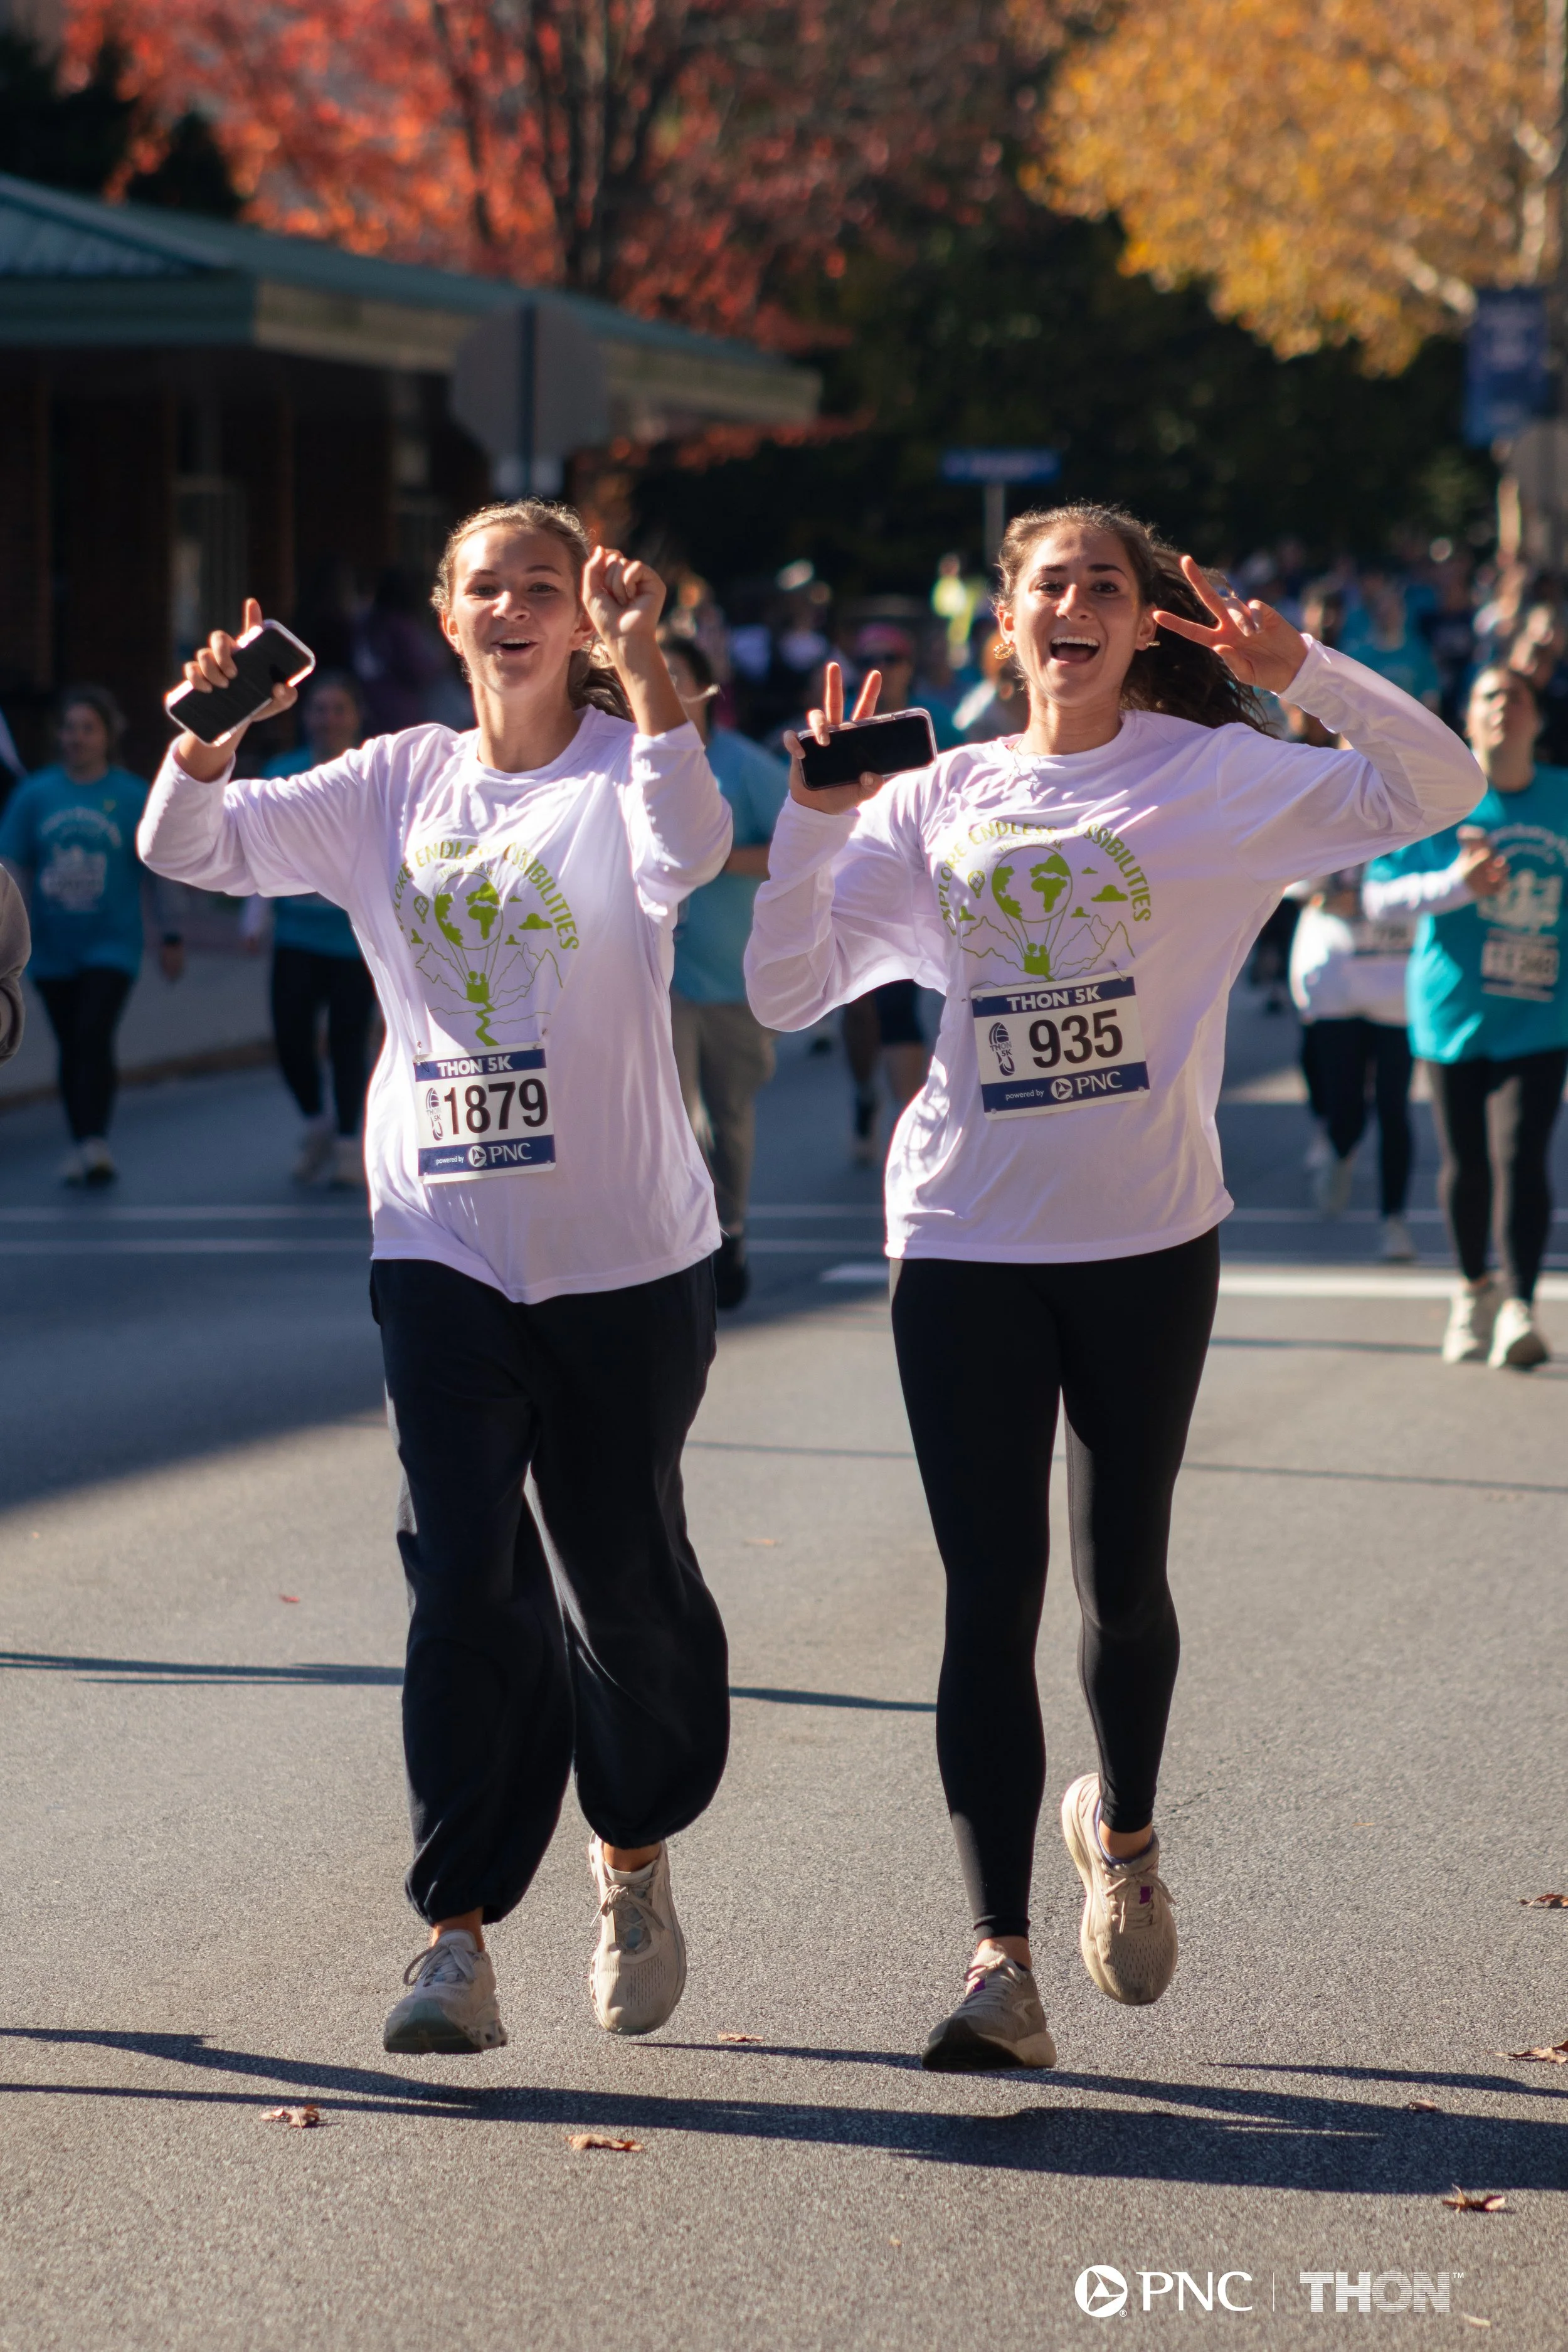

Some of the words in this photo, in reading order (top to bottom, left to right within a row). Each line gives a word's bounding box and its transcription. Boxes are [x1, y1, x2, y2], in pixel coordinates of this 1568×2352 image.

[1074, 985, 1102, 1004] 5K
[990, 1041, 1012, 1052] THON
[1029, 1009, 1123, 1069] 935
[1002, 1048, 1012, 1057] 5K
[488, 1056, 513, 1072] 5K
[1005, 1090, 1035, 1101] powered
[1036, 1089, 1044, 1098] by
[1074, 1071, 1123, 1094] PNC
[444, 1078, 548, 1135] 1879
[433, 1114, 442, 1122] 5K
[436, 1156, 458, 1166] powered
[458, 1155, 464, 1163] by
[487, 1143, 532, 1163] PNC
